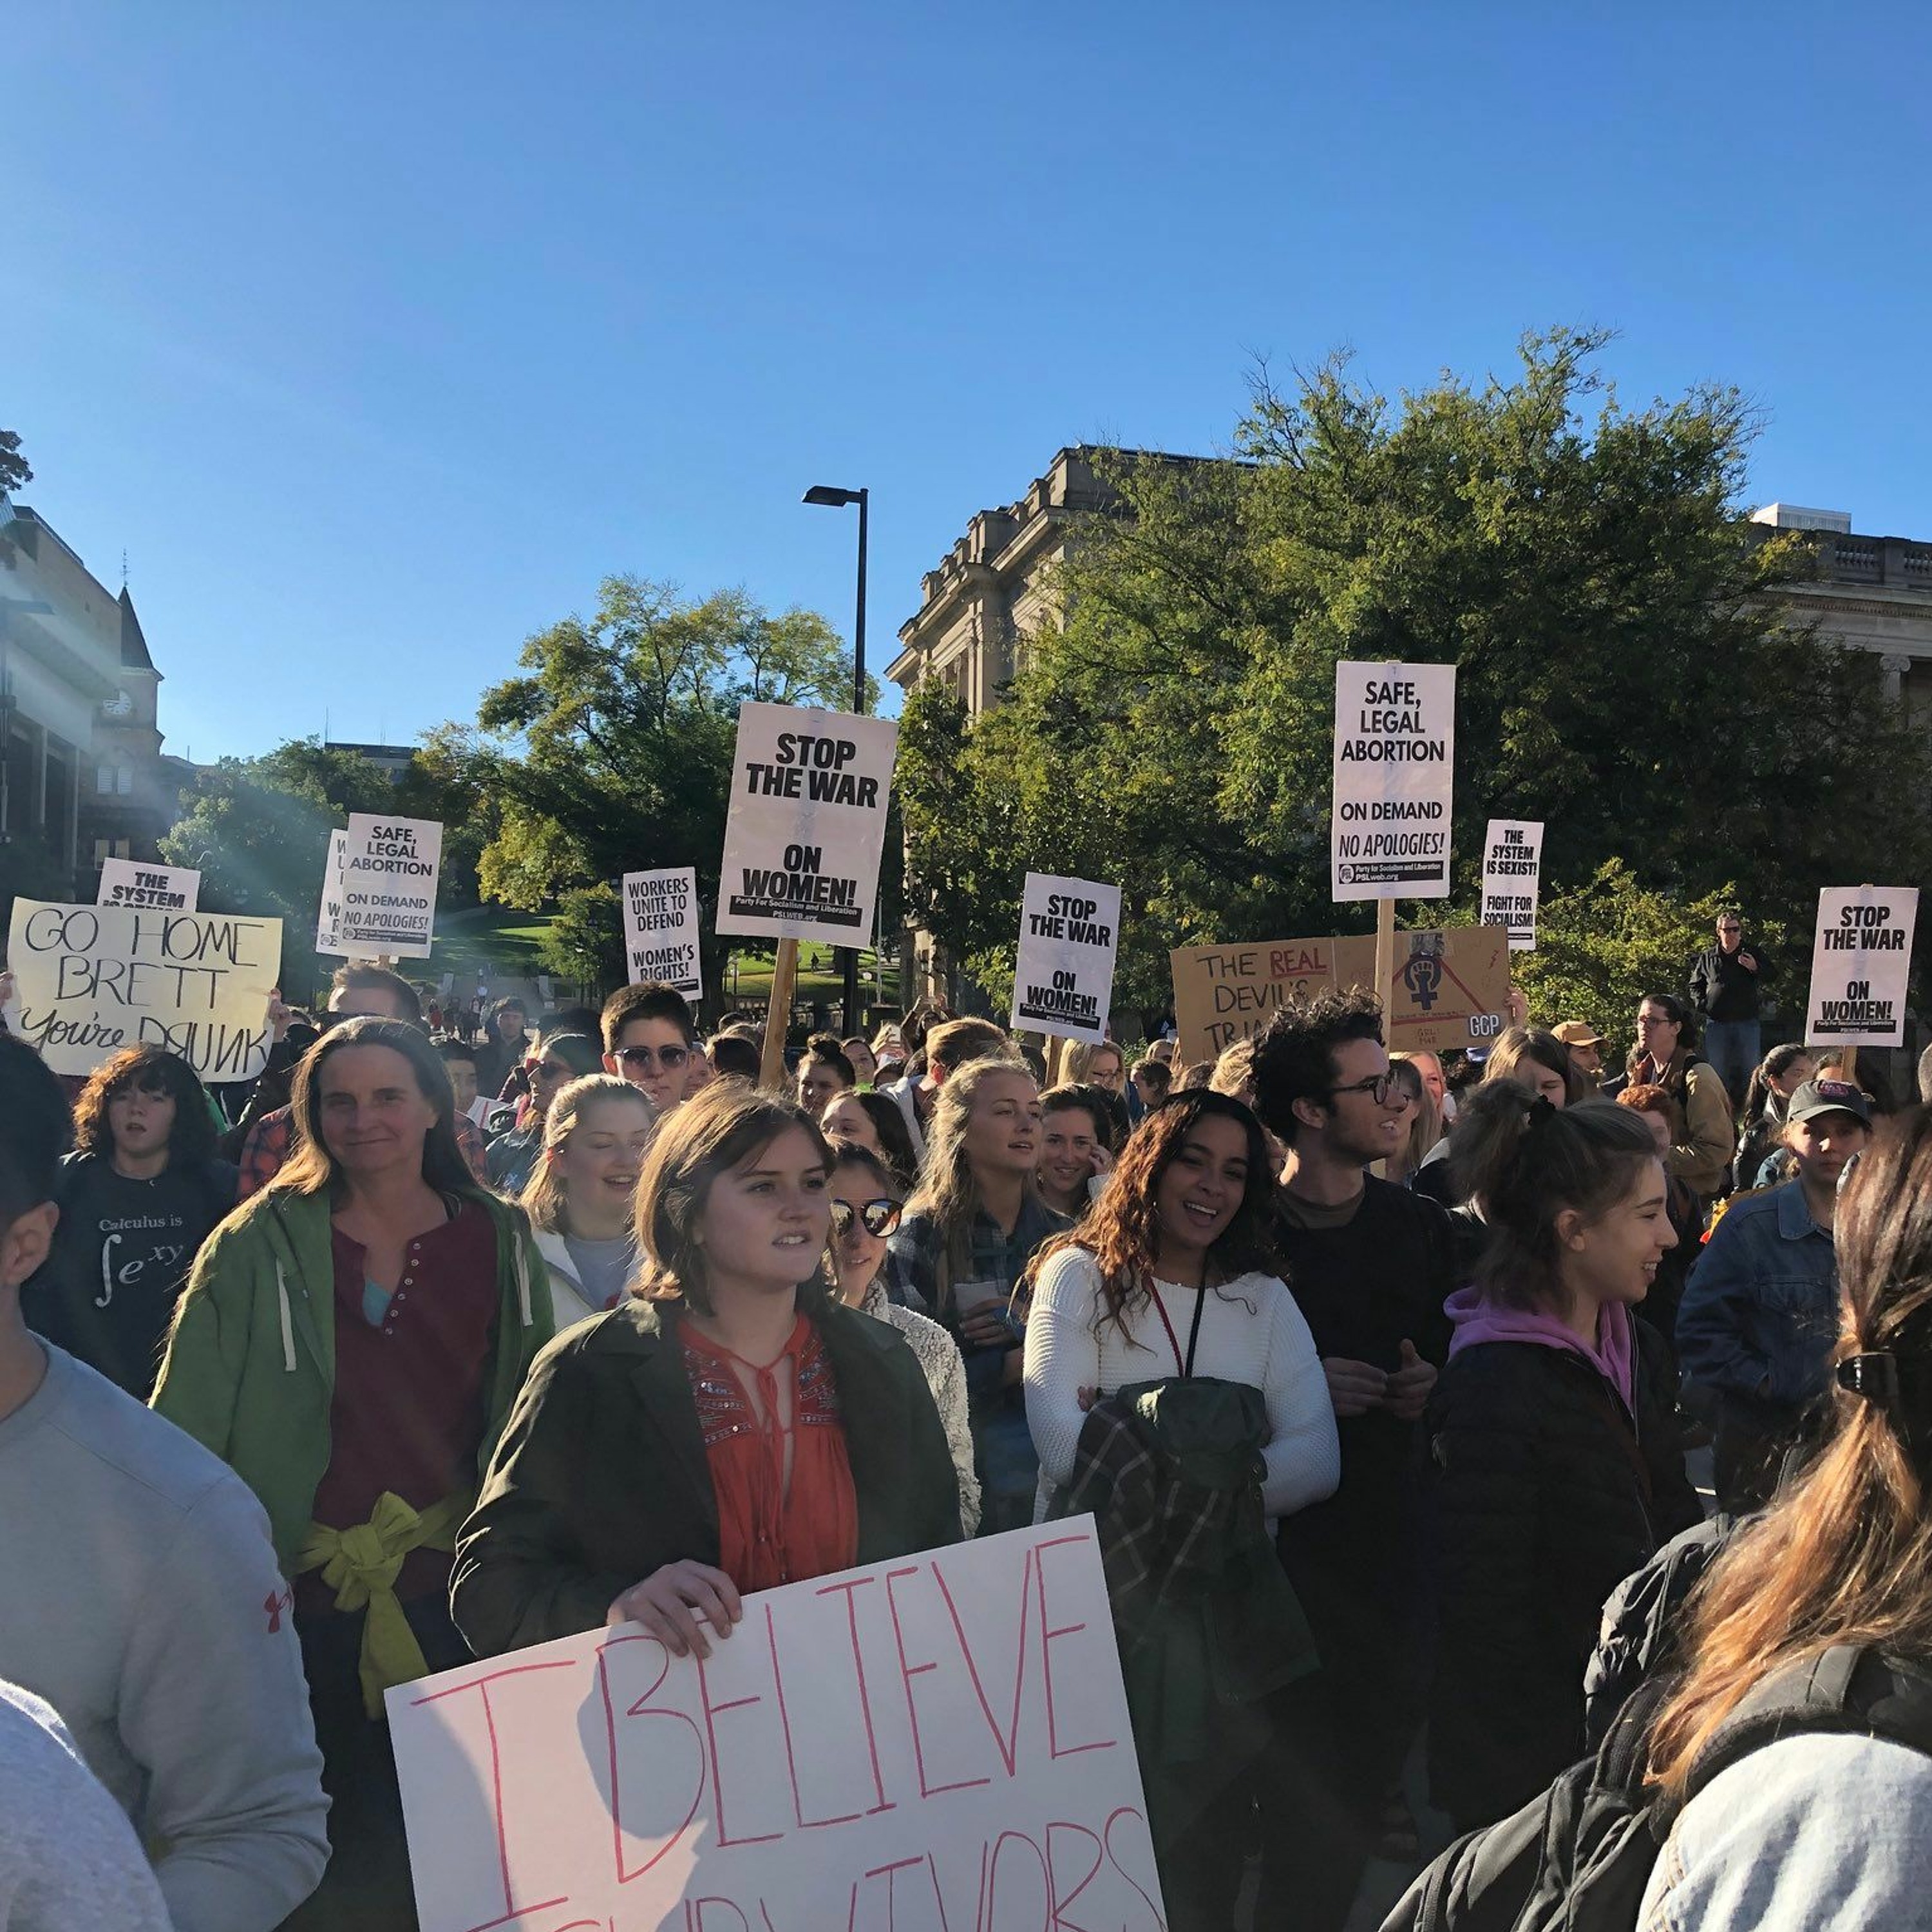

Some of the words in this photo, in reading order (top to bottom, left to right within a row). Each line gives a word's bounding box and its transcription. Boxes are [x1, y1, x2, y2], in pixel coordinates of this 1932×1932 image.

[1365, 681, 1421, 709] SAFE,
[1361, 710, 1425, 734] LEGAL
[776, 733, 856, 770] STOP
[1341, 740, 1444, 761] ABORTION
[746, 763, 800, 799] THE
[808, 771, 878, 808] WAR
[1341, 802, 1367, 821] ON
[1371, 802, 1443, 820] DEMAND
[371, 826, 417, 845] SAFE,
[1339, 835, 1360, 858] NO
[1363, 832, 1445, 857] APOLOGIES!
[1504, 829, 1524, 844] THE
[366, 841, 419, 859] LEGAL
[783, 844, 822, 874] ON
[1492, 845, 1534, 860] SYSTEM
[349, 857, 432, 876] ABORTION
[1486, 860, 1497, 875] IS
[1498, 861, 1537, 876] SEXIST!
[135, 872, 169, 889] THE
[629, 877, 689, 898] WORKERS
[743, 869, 857, 905] WOMEN!
[111, 885, 185, 908] SYSTEM
[346, 893, 368, 904] ON
[371, 895, 428, 909] DEMAND
[632, 896, 668, 915] UNITE
[671, 895, 687, 910] TO
[1487, 895, 1513, 911] FIGHT
[1515, 896, 1532, 911] FOR
[768, 900, 804, 909] Socialism
[806, 903, 819, 912] and
[820, 904, 857, 916] Liberation
[1048, 894, 1097, 921] STOP
[1840, 906, 1890, 927] STOP
[343, 911, 361, 925] NO
[364, 913, 428, 929] APOLOGIES!
[638, 911, 684, 931] DEFEND
[1029, 914, 1065, 939] THE
[1068, 921, 1111, 947] WAR
[1483, 913, 1533, 927] SOCIALISM!
[26, 909, 99, 952] GO
[132, 915, 265, 966] HOME
[1823, 929, 1857, 950] THE
[1861, 929, 1905, 950] WAR
[633, 944, 694, 967] WOMEN'S
[1197, 953, 1258, 978] THE
[1270, 947, 1327, 977] REAL
[640, 962, 689, 981] RIGHTS!
[1052, 971, 1076, 991] ON
[54, 956, 229, 1009] BRETT
[1847, 981, 1870, 1000] ON
[1027, 985, 1097, 1016] WOMEN!
[1822, 1001, 1893, 1019] WOMEN!
[18, 1007, 124, 1052] You're
[99, 1215, 166, 1231] Calculus
[169, 1214, 183, 1226] is
[410, 1660, 577, 1932] I
[596, 1535, 1119, 1884] BELIEVE
